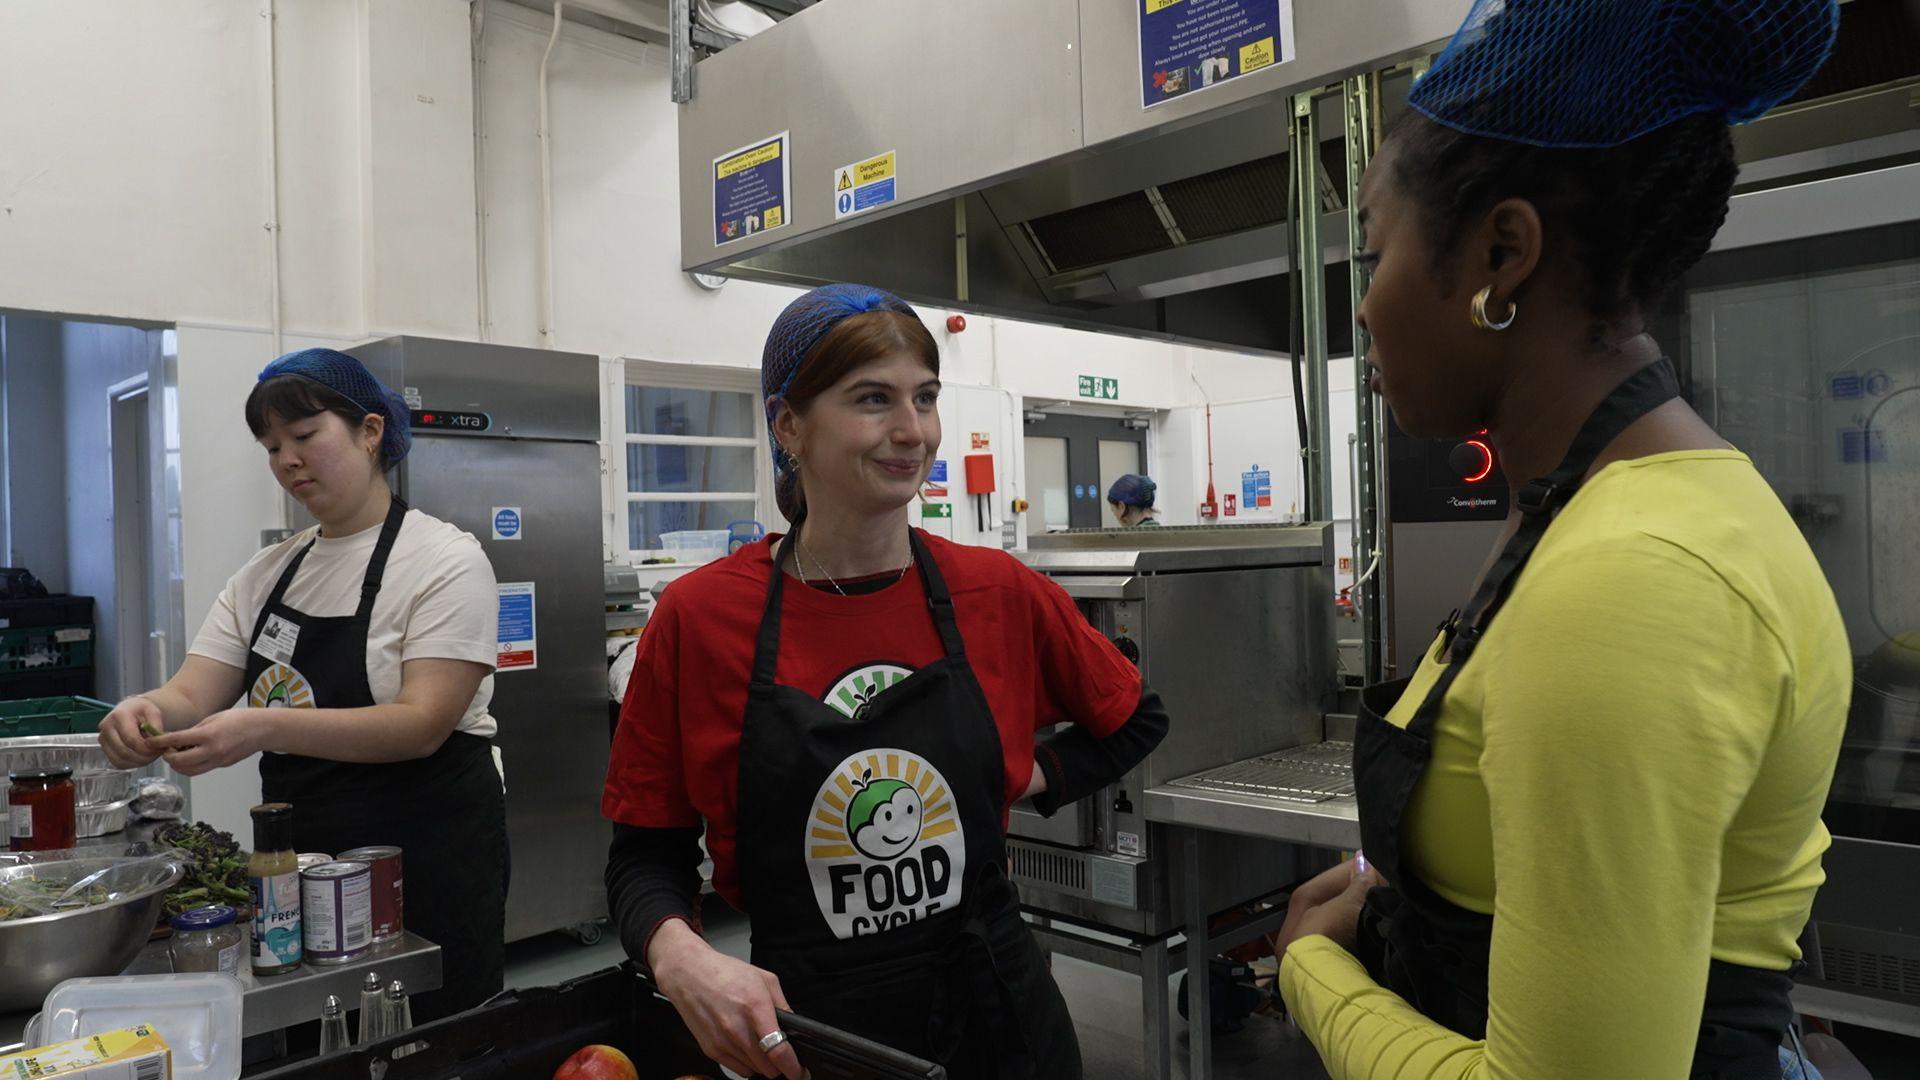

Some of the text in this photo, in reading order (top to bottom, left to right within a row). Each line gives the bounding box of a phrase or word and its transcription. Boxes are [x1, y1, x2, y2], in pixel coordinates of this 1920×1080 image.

[1186, 17, 1198, 26] have
[1198, 14, 1206, 22] not
[1207, 10, 1219, 18] been
[1178, 40, 1190, 48] have
[1199, 34, 1208, 42] got
[1208, 30, 1220, 39] your
[1220, 22, 1238, 33] correct
[1154, 57, 1171, 66] Always
[1245, 52, 1269, 64] Caution
[859, 159, 888, 173] Dangerous
[863, 169, 885, 181] Machine
[1079, 377, 1091, 386] Fire
[1080, 387, 1091, 395] exit
[451, 415, 480, 427] xtra
[828, 844, 951, 914] FOOD
